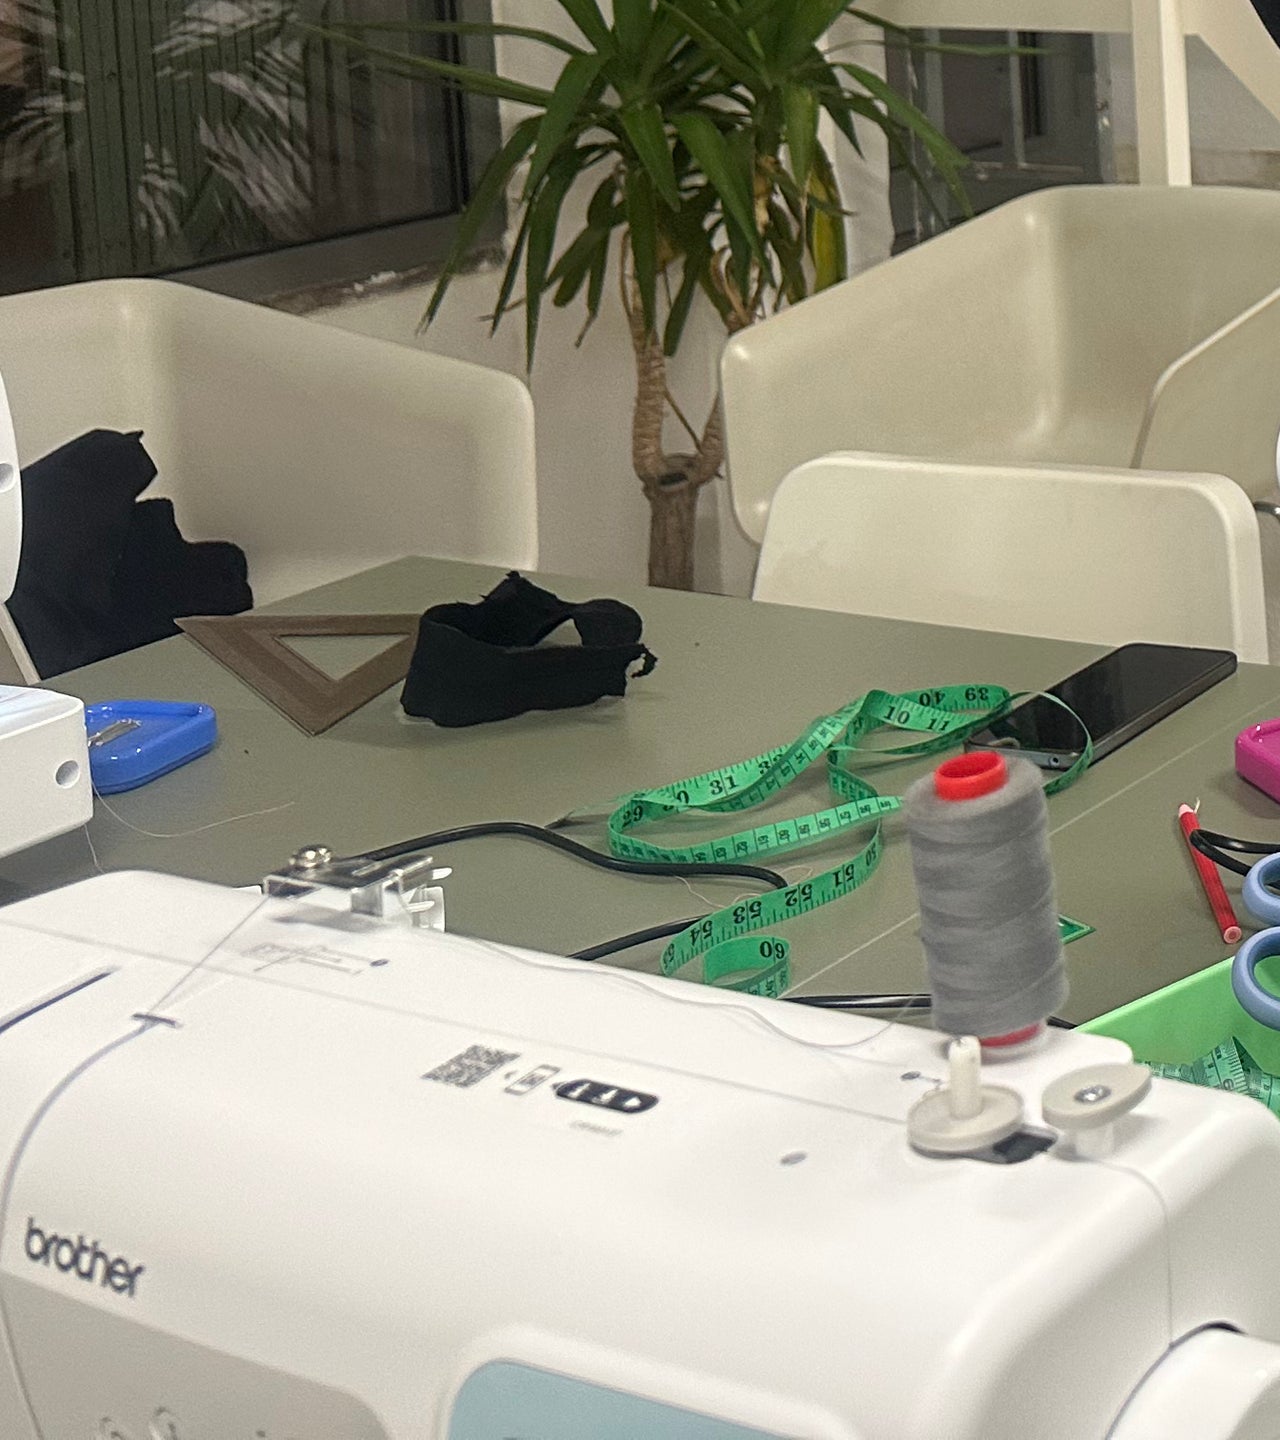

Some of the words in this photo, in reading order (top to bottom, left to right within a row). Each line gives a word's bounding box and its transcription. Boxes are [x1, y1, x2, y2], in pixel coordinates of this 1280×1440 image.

[918, 691, 946, 707] 40
[965, 687, 989, 702] 39
[883, 705, 910, 725] 10
[926, 717, 949, 731] 11
[622, 805, 643, 828] 29
[708, 774, 740, 797] 31
[831, 863, 855, 887] 51
[784, 882, 813, 907] 52
[732, 900, 762, 924] 53
[689, 919, 713, 946] 54
[758, 940, 786, 960] 60
[24, 1216, 144, 1298] brother
